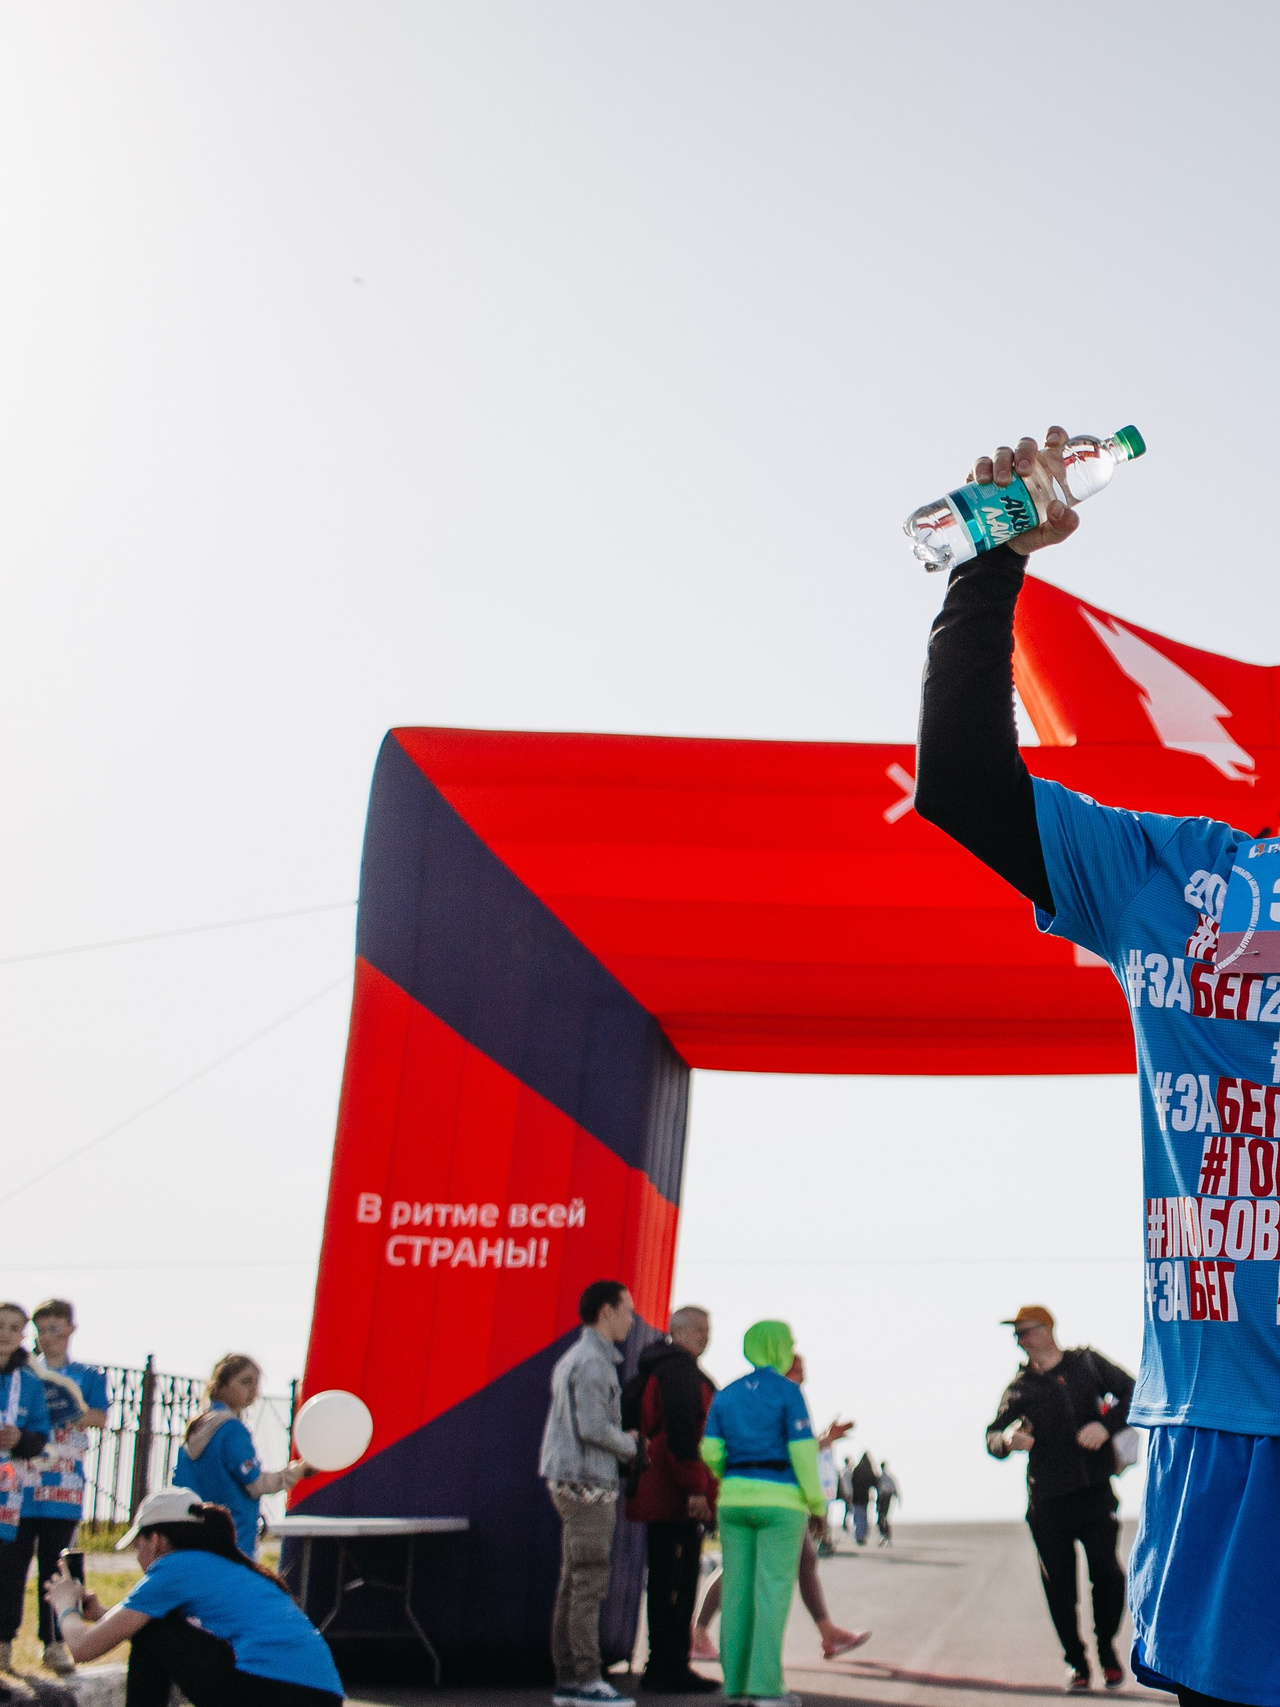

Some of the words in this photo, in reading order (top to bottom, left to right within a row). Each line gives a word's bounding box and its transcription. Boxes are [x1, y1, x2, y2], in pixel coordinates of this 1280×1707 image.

[981, 506, 1016, 546] ЛАЙ
[1000, 495, 1031, 532] АКВ
[356, 1192, 382, 1224] В
[390, 1200, 499, 1229] ритме
[508, 1197, 586, 1229] всей
[385, 1234, 550, 1269] СТРАНЫ!
[1146, 1261, 1238, 1322] #ЗАБЕГ
